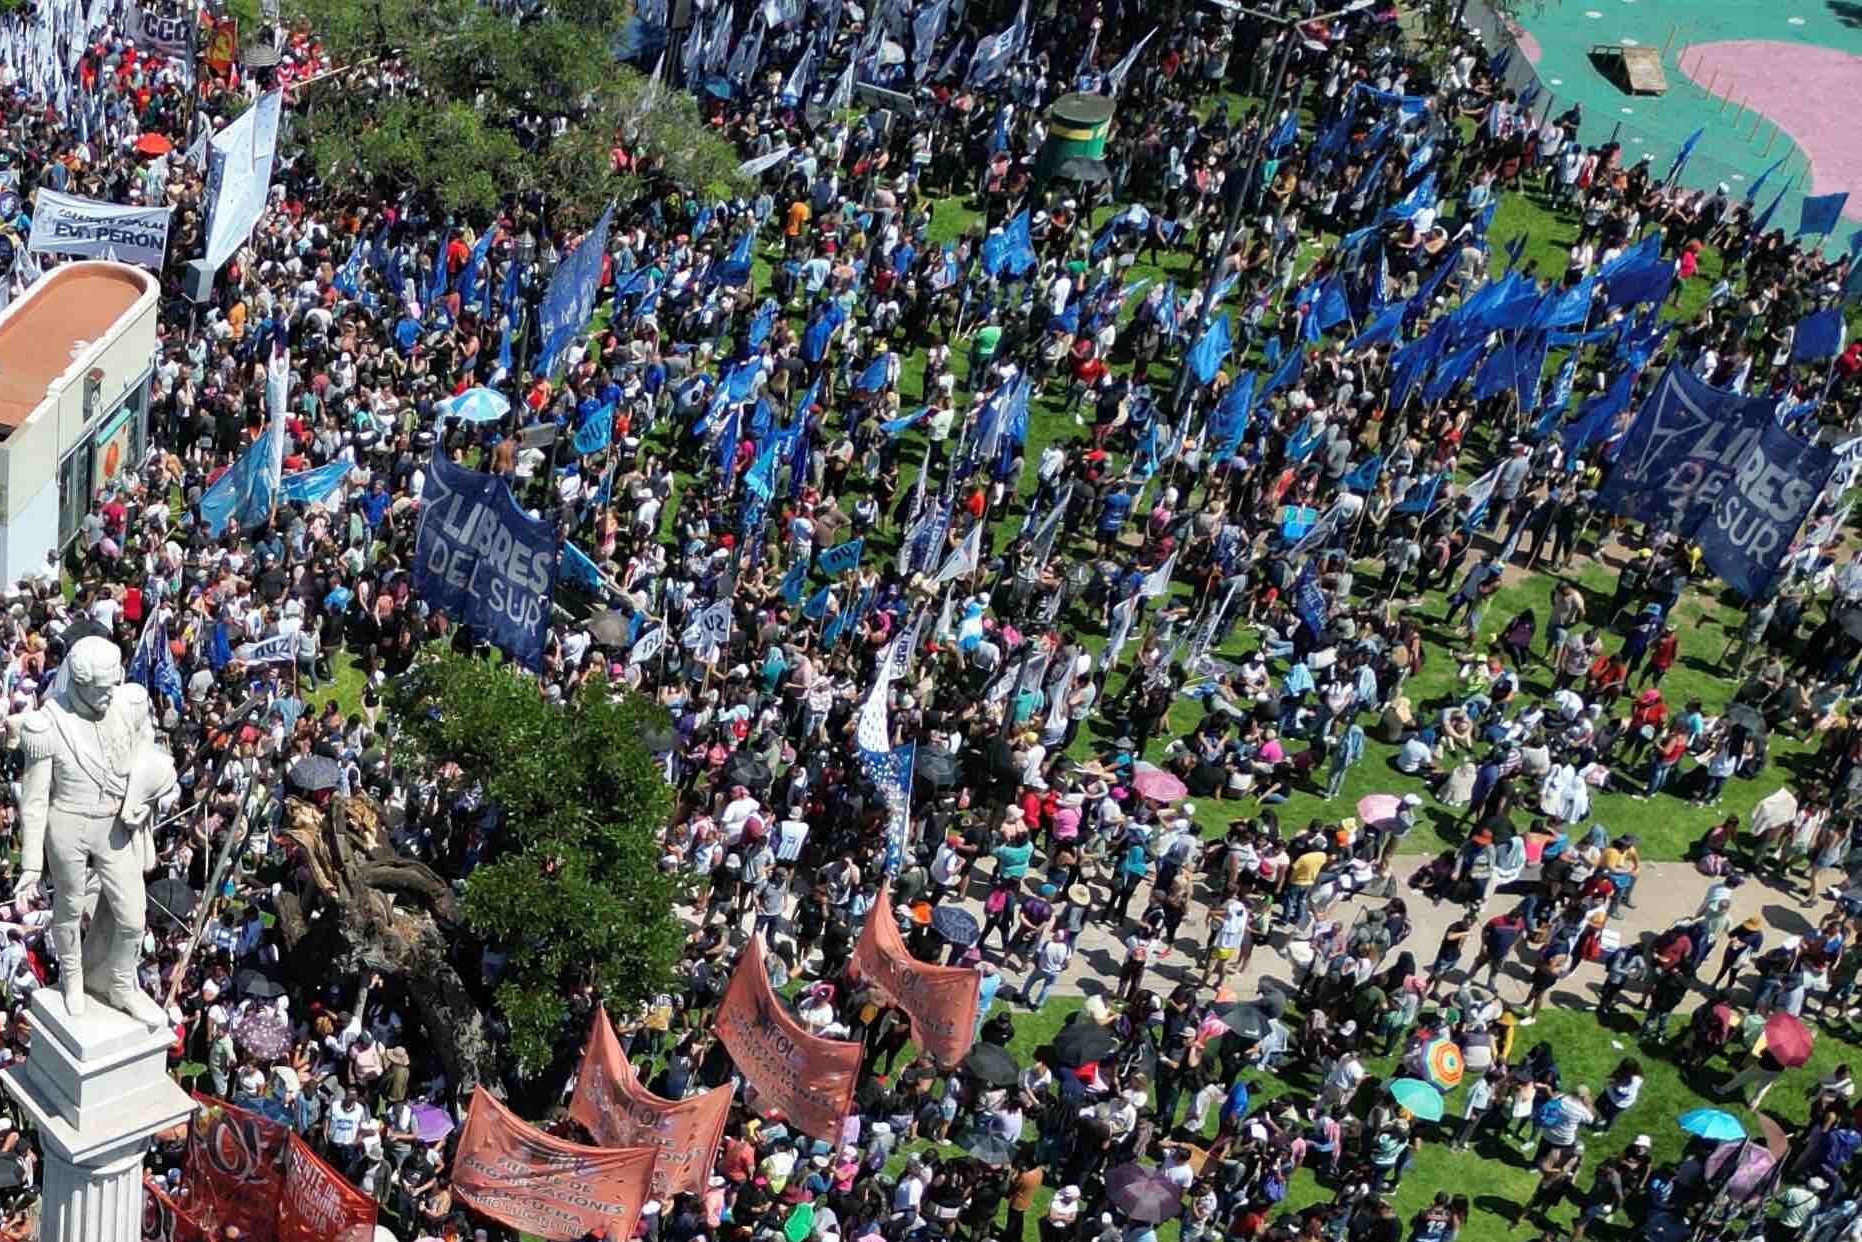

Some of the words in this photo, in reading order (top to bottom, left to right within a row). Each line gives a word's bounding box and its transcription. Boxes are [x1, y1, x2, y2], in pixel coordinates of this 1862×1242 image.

[95, 227, 165, 250] PERÓN
[441, 493, 553, 595] LIBRES
[1717, 495, 1779, 568] SUR
[488, 577, 543, 637] SUR
